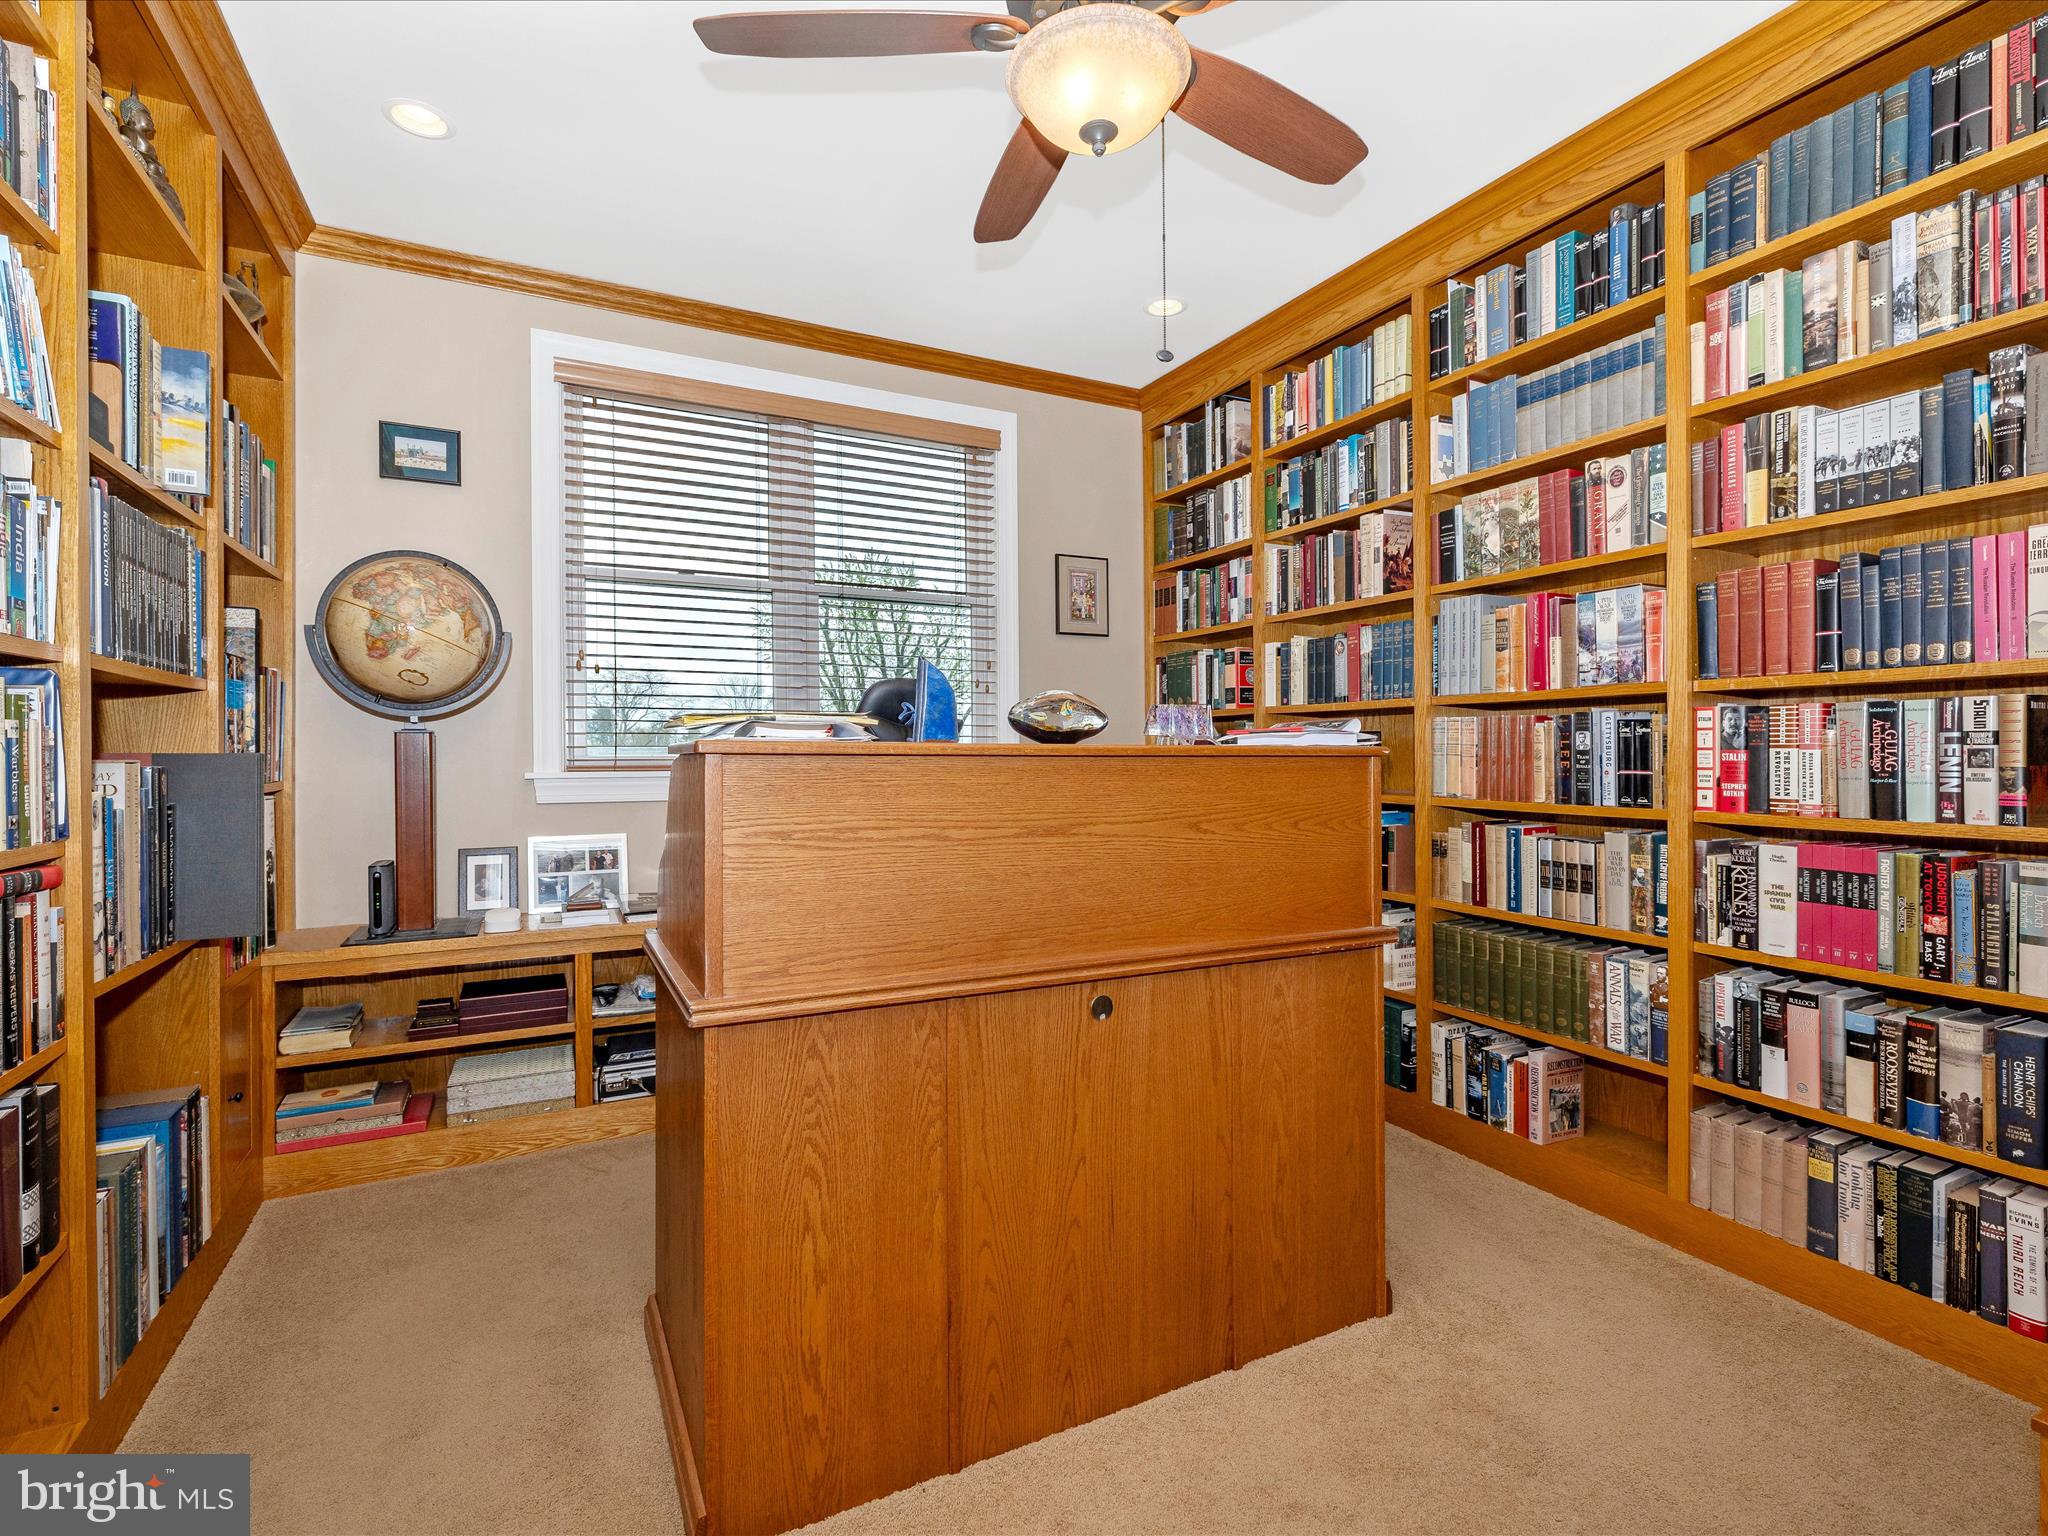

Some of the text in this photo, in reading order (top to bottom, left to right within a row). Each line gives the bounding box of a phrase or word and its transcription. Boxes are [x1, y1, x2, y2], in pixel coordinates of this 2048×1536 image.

[2002, 235, 2011, 266] WAR
[2027, 225, 2037, 257] WAR
[1980, 242, 1989, 273] WAR
[1993, 375, 2020, 387] PARIS
[1594, 490, 1605, 537] GRANT
[15, 524, 25, 574] India
[1560, 740, 1570, 770] LEE
[1721, 753, 1747, 761] STALIN
[1850, 729, 1863, 769] GULAG
[1869, 719, 1885, 772] Archipelago
[1885, 730, 1898, 772] GULAG
[11, 745, 20, 803] Warblers
[1774, 751, 1782, 797] REVOLUTION
[1783, 751, 1791, 797] THE RUSSIAN
[1940, 732, 1961, 792] LENIN
[1659, 844, 1668, 863] BATTLE
[1659, 880, 1668, 904] FREEDOM
[1731, 865, 1748, 916] KEYNES
[1764, 890, 1792, 898] SPANISH
[1820, 871, 1828, 903] AUSCHWITZ
[1868, 876, 1876, 909] AUSCHWITZ
[1880, 859, 1890, 911] FIGHTER PILOT
[1924, 862, 1933, 913] AT TOKYO
[1935, 862, 1947, 915] JUDGMENT
[2034, 895, 2047, 928] Dietrich
[1924, 941, 1933, 962] BASS
[1936, 937, 1947, 961] GARY
[1987, 904, 2000, 968] STALINGRAD
[9, 918, 17, 1030] PANDORA'S KEEPERS
[1609, 964, 1622, 1045] ANNALS WAR
[1716, 982, 1726, 1020] APPEASEMENT
[1789, 998, 1816, 1008] BULLOCK
[1907, 1041, 1928, 1050] Diaries
[1916, 1036, 1928, 1045] The
[1547, 1058, 1584, 1072] RECONSTRUCTION
[1907, 1053, 1937, 1063] Alexander
[1908, 1059, 1936, 1069] Cadogan
[2025, 1056, 2036, 1086] HENRY
[1531, 1066, 1539, 1114] RECONSTRUCTION
[1886, 1041, 1898, 1112] ROOSEVELT
[2014, 1061, 2024, 1108] CHANNON
[2005, 1133, 2033, 1144] HEFFER
[2007, 1128, 2031, 1139] SIMON
[1840, 1160, 1850, 1223] for Trouble
[1850, 1164, 1863, 1210] Looking
[1980, 1220, 2006, 1232] WAR
[2009, 1210, 2032, 1220] RICHARD
[2009, 1215, 2040, 1229] EVANS
[1980, 1231, 2006, 1242] MERCY
[2029, 1244, 2037, 1253] THE
[2013, 1234, 2024, 1296] THIRD REICH
[2029, 1256, 2037, 1276] COMING
[2029, 1286, 2037, 1296] THE
